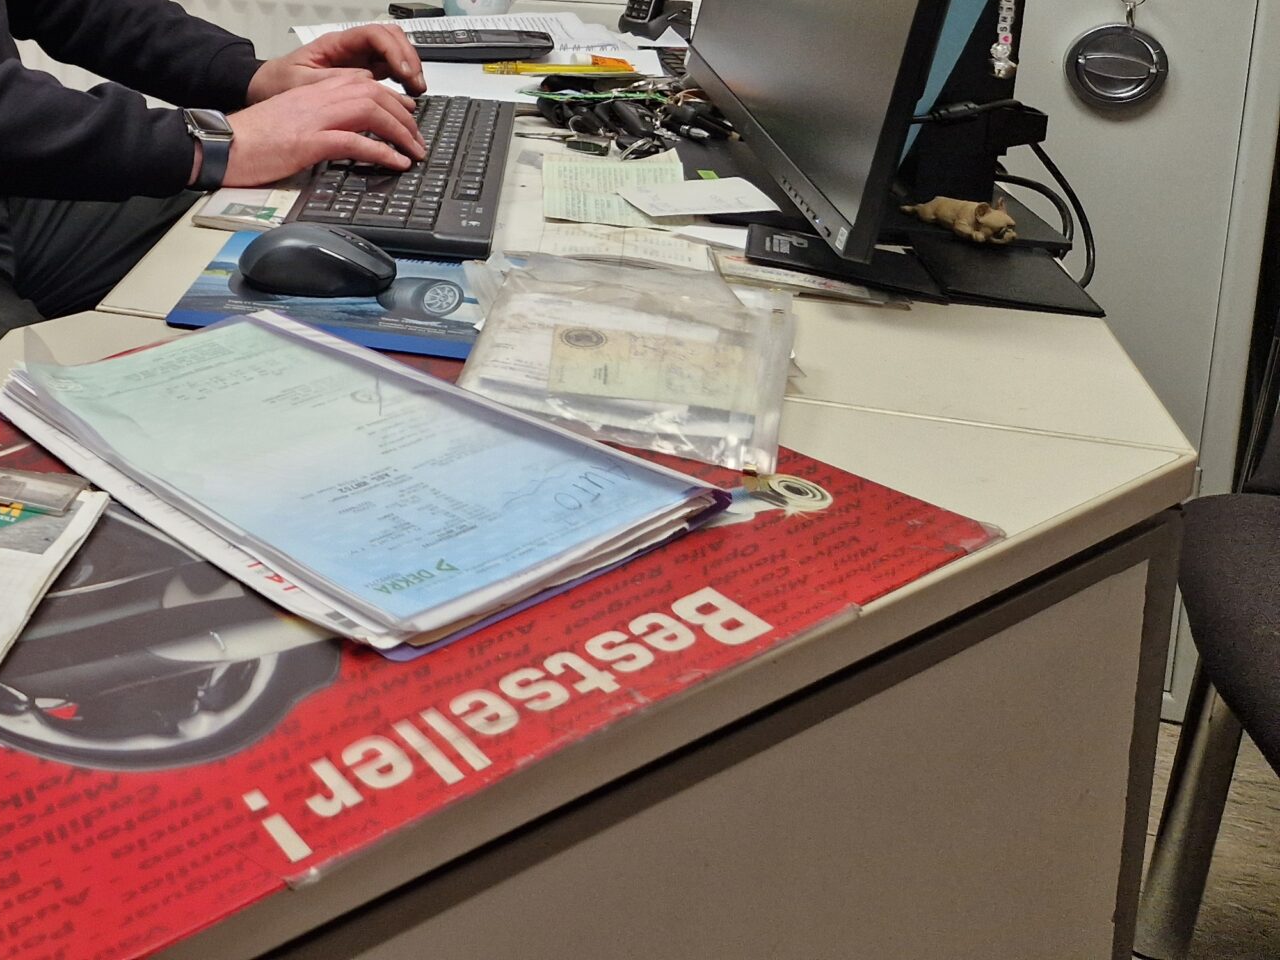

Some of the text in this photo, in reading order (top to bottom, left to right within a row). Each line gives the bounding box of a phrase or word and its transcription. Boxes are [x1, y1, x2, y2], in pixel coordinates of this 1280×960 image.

[373, 568, 435, 595] DEKRA
[701, 542, 760, 578] Opel
[562, 579, 675, 636] Peugeot
[466, 619, 537, 659] Audi
[69, 786, 203, 854] Proton
[110, 796, 234, 860] Lancia
